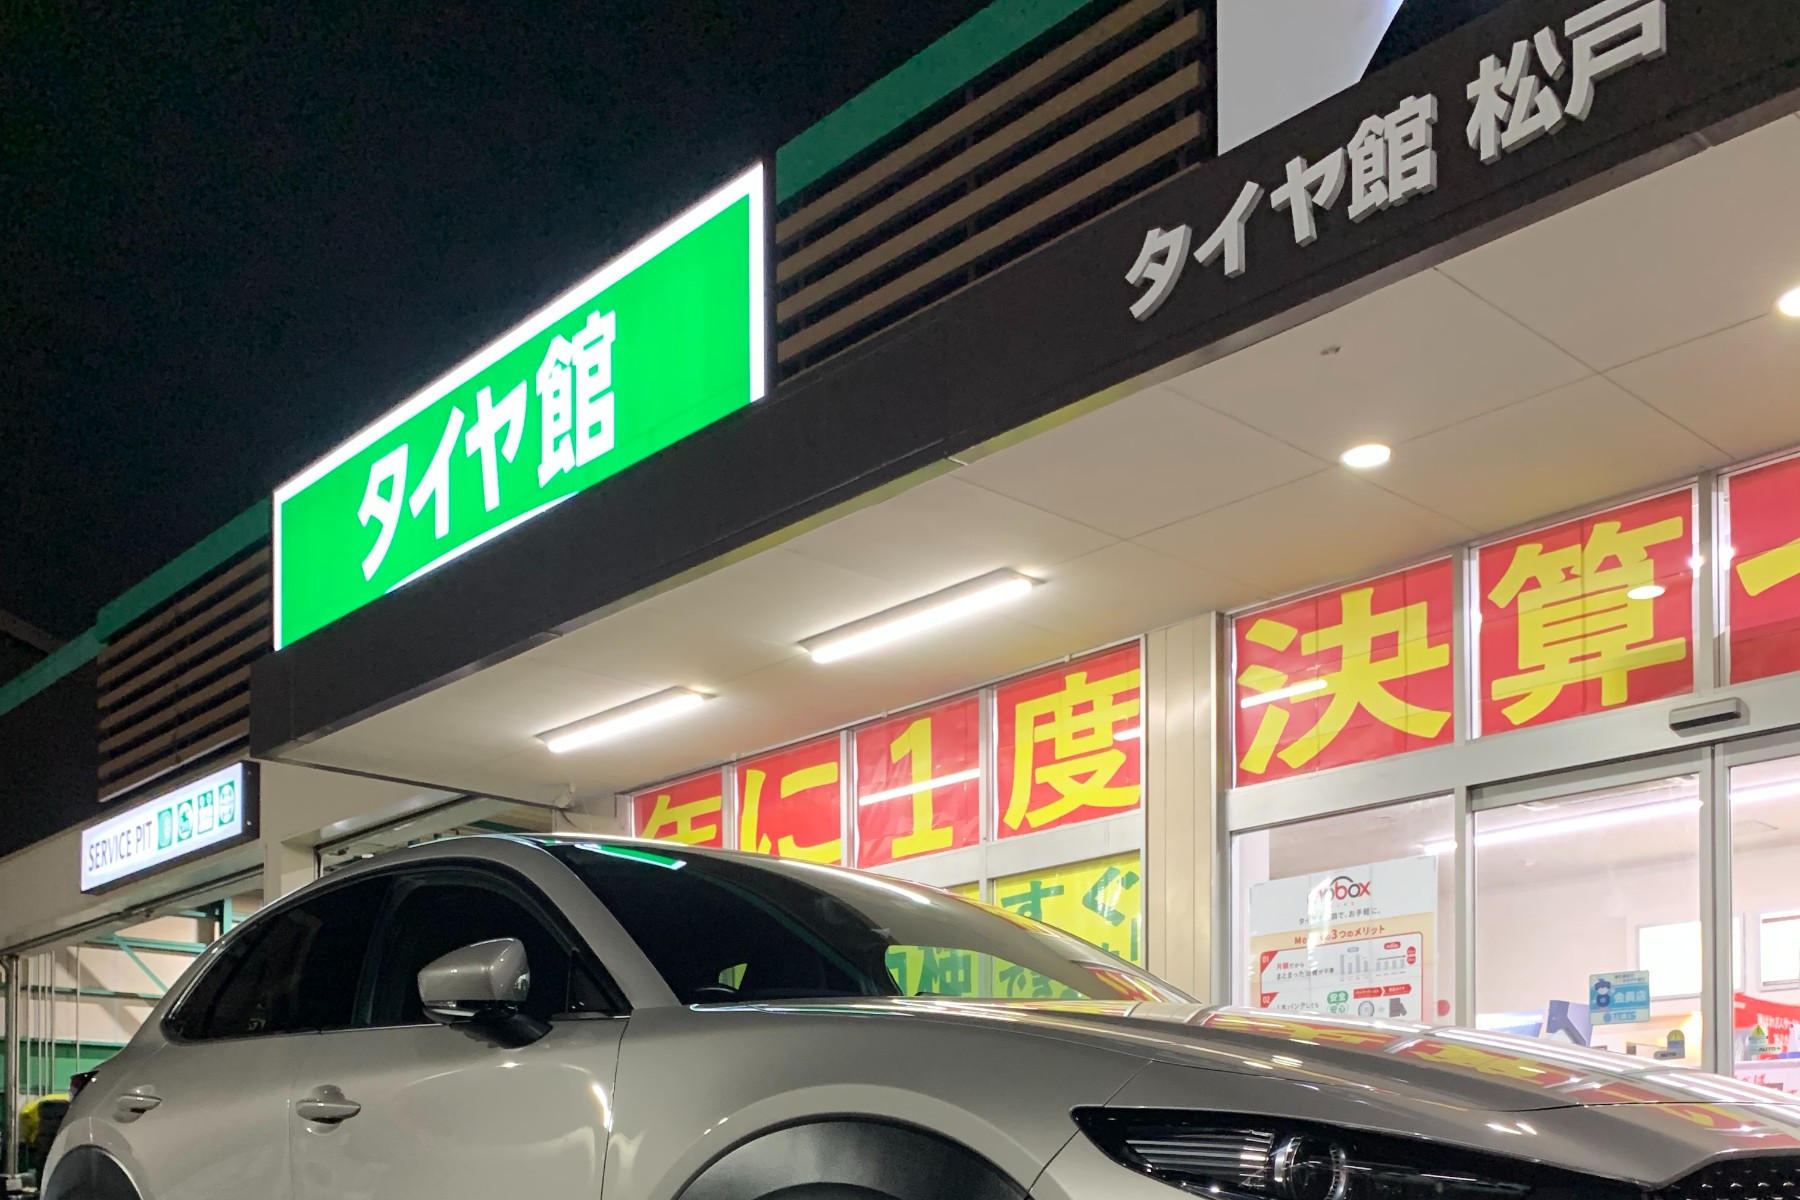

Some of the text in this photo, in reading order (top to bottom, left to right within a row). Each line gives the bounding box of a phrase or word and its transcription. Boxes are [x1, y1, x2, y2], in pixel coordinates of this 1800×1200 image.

[1124, 0, 1667, 321] タイヤ館 松戸
[357, 309, 617, 582] タイヤ館
[1238, 516, 1800, 774] 決算
[88, 820, 153, 872] SERVICE PIT
